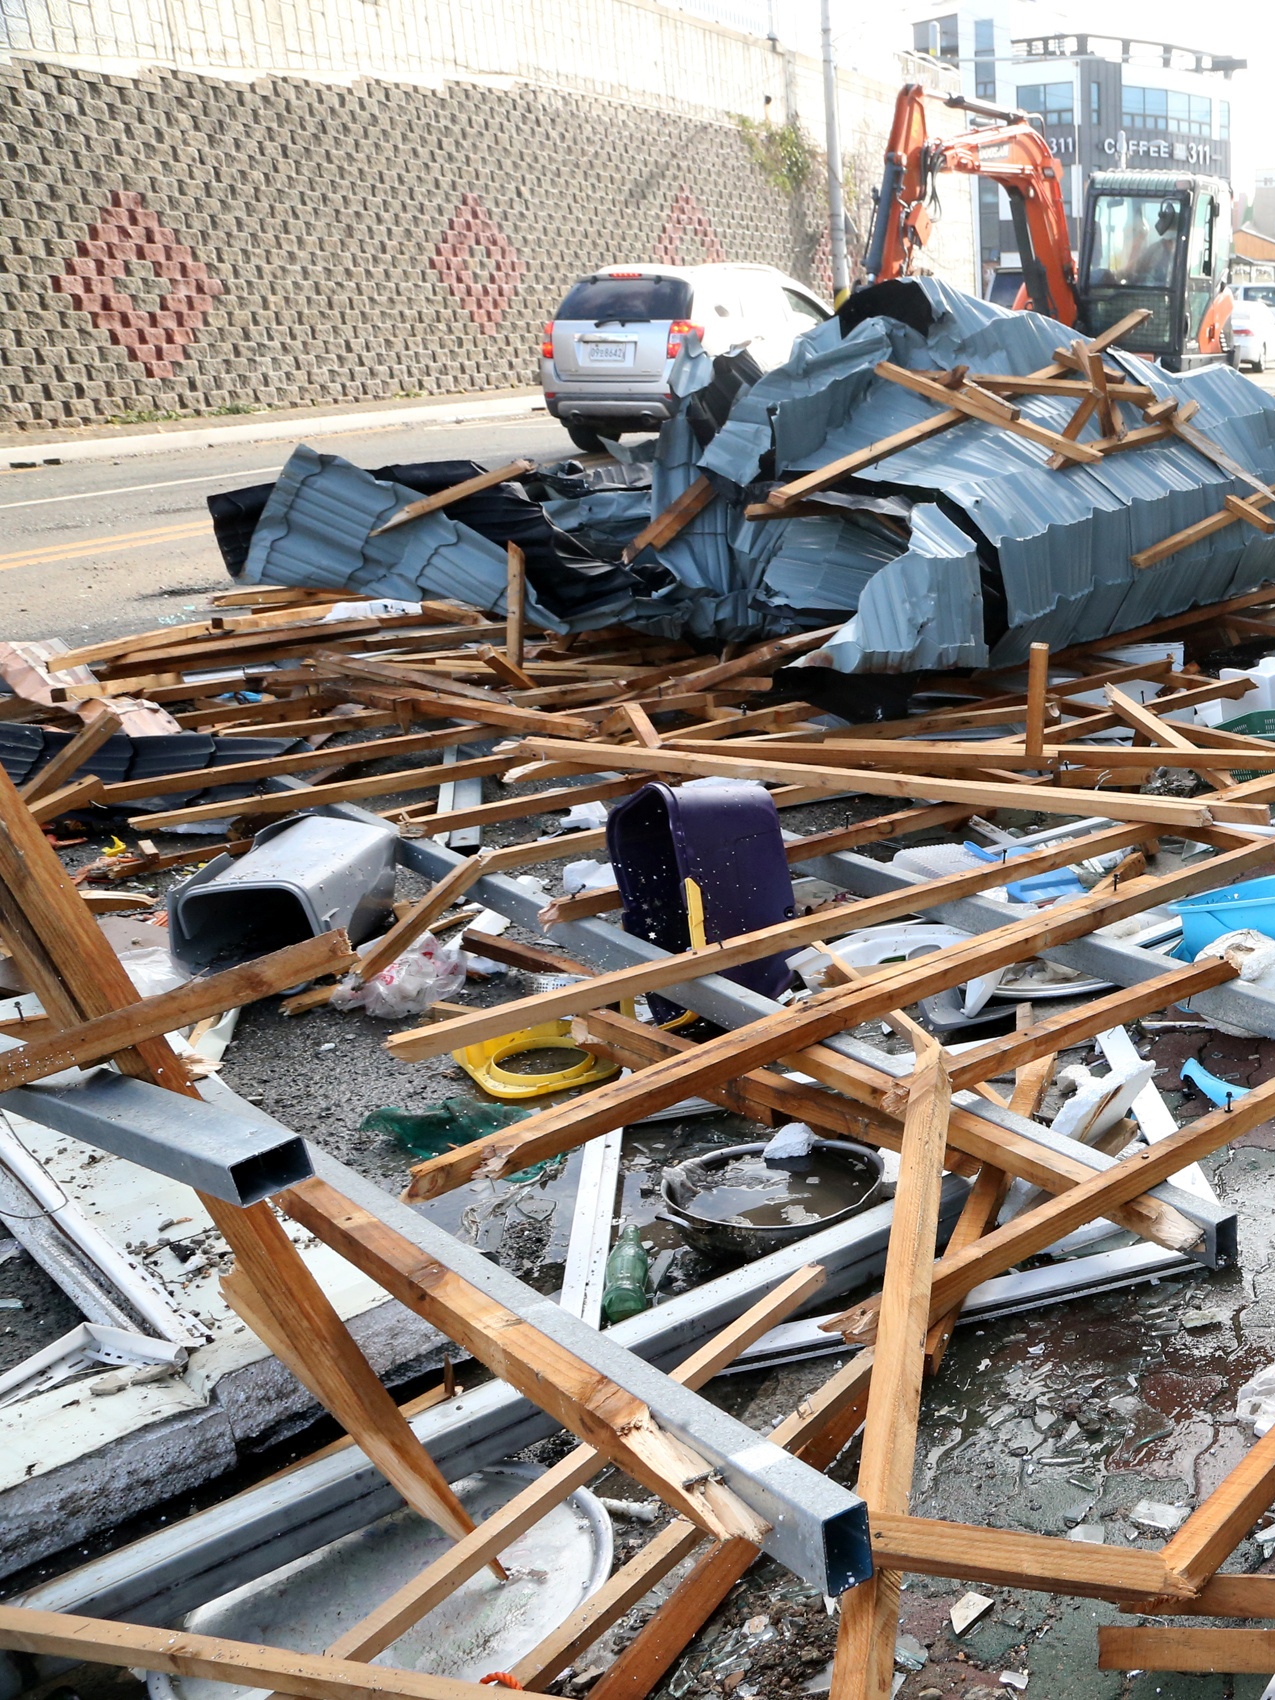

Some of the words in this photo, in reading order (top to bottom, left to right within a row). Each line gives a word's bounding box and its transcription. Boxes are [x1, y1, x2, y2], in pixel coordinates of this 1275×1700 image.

[1050, 138, 1074, 154] 311
[1104, 138, 1170, 159] CFFEE
[1187, 142, 1211, 167] 311
